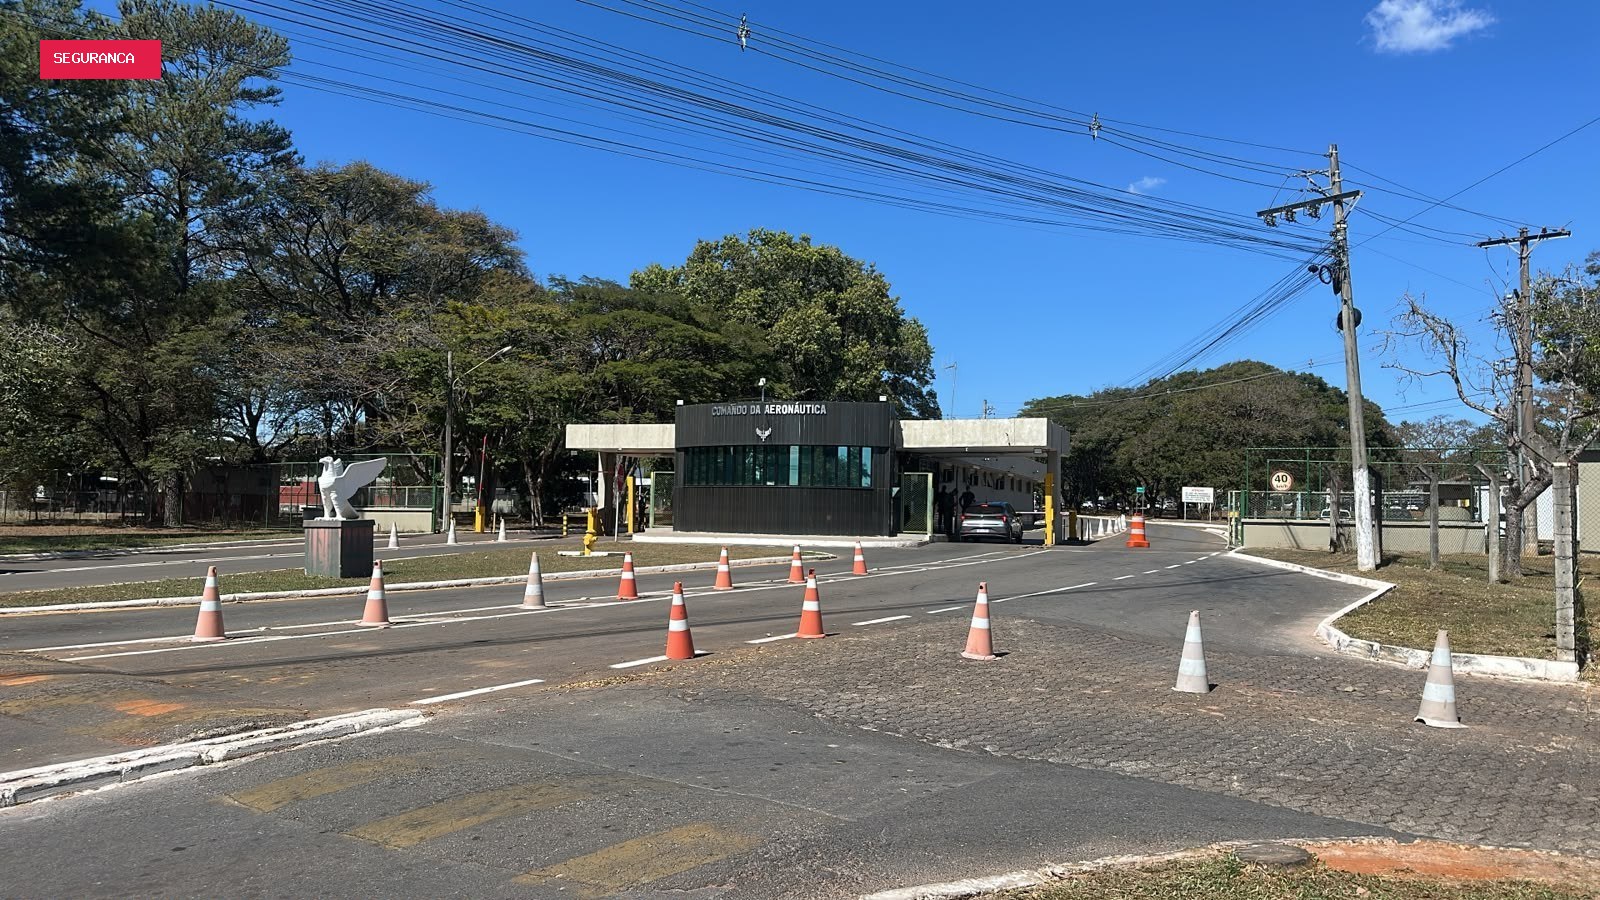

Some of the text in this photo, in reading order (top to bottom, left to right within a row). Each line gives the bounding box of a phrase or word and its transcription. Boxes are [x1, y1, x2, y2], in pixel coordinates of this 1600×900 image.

[712, 401, 827, 416] COMANDO DA AERONÁUTICA
[1274, 474, 1288, 483] 40
